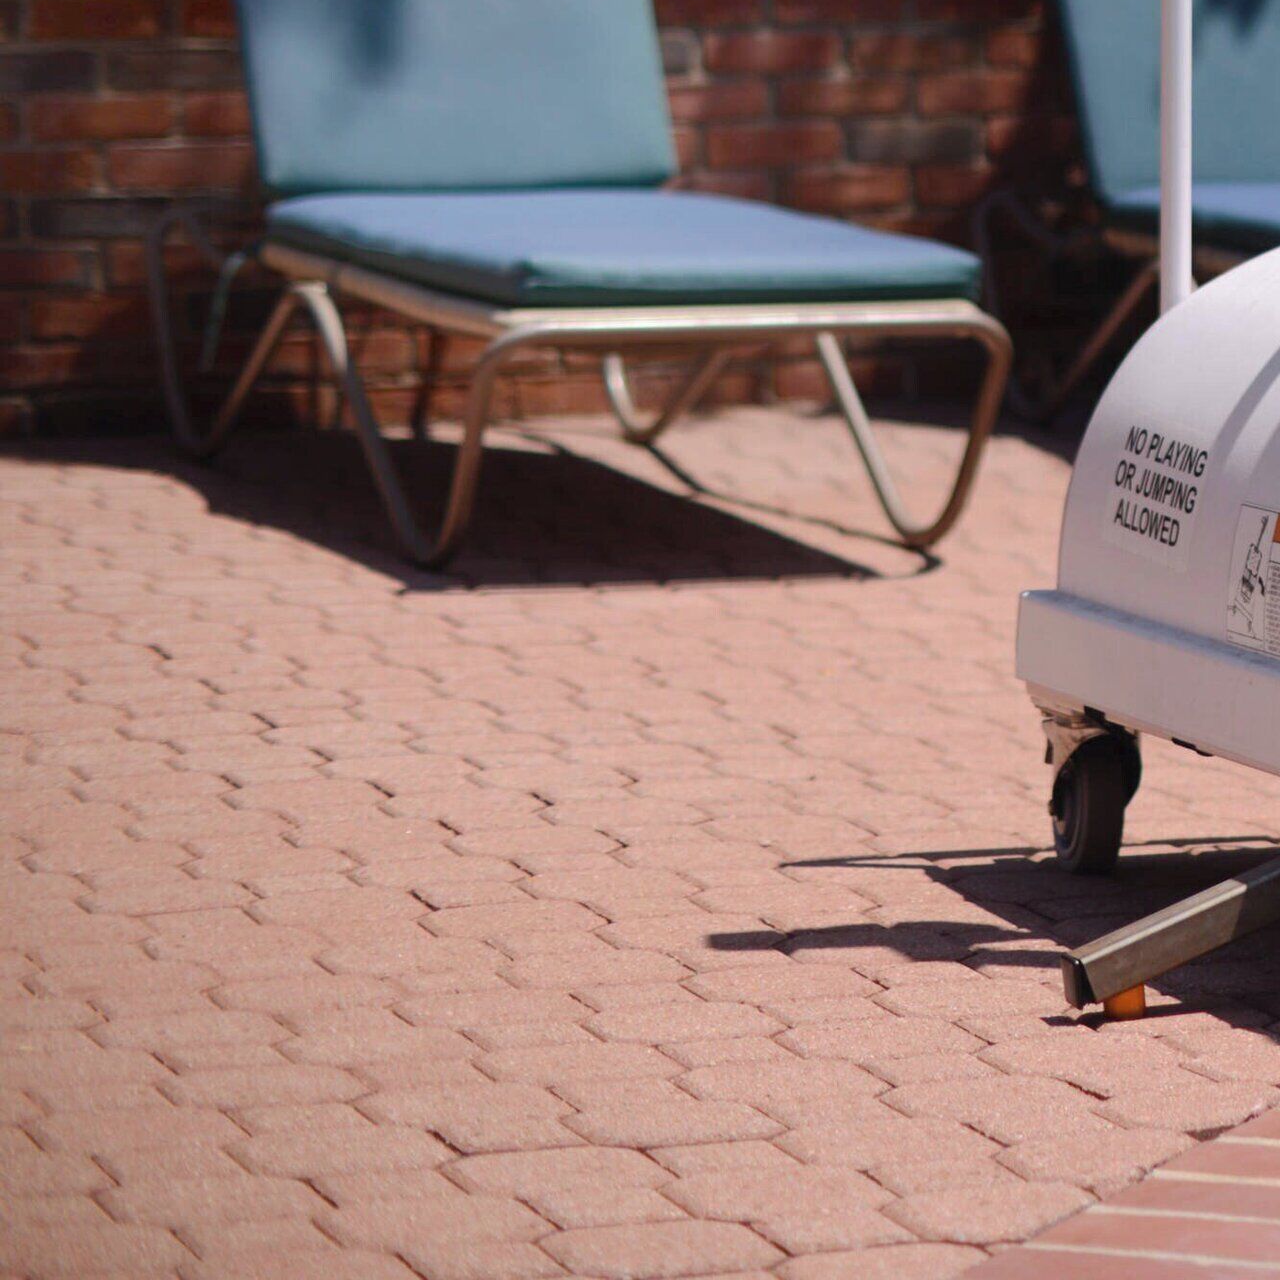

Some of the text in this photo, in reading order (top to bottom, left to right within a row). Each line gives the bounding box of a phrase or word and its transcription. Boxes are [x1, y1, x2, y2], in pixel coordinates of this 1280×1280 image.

[1125, 425, 1208, 477] NO PLAYING
[1114, 459, 1198, 514] OR JUMPING
[1113, 498, 1180, 548] ALLOWED
